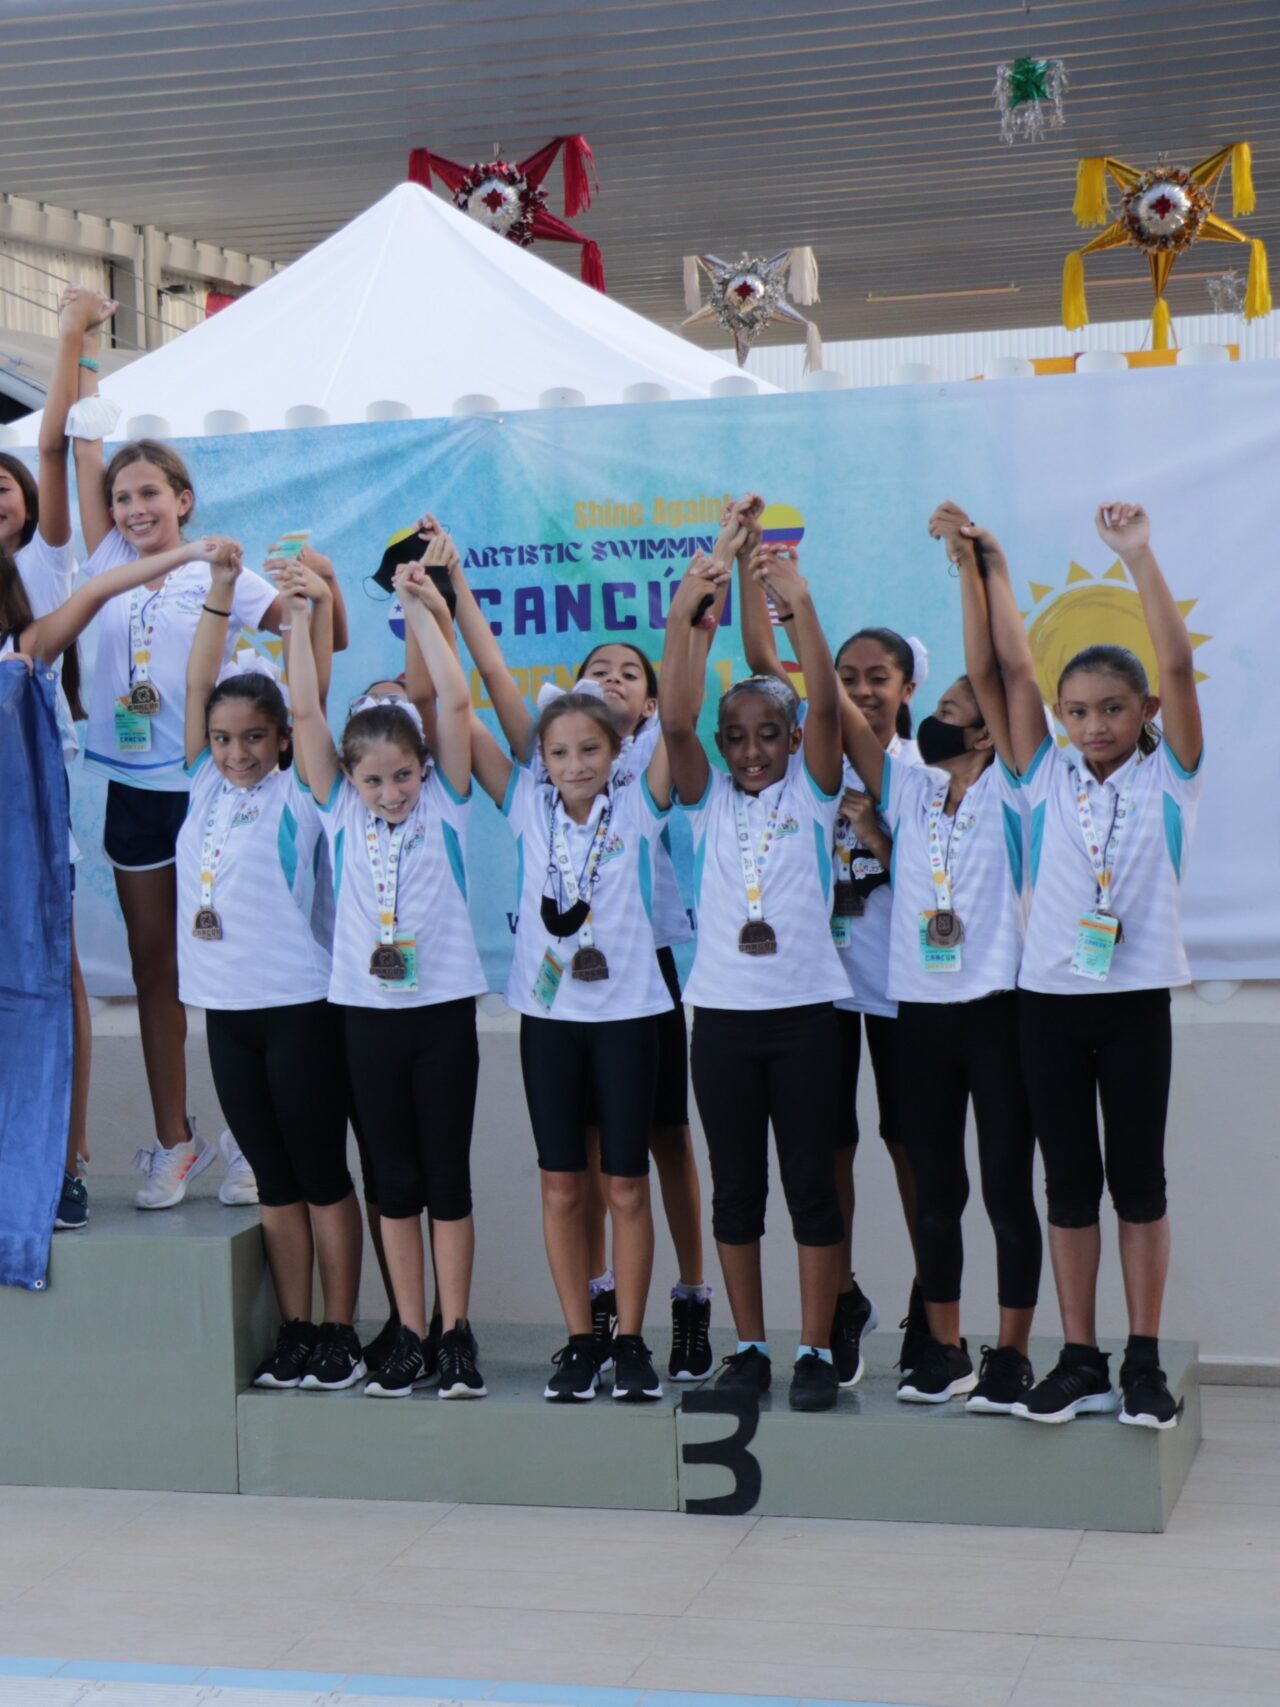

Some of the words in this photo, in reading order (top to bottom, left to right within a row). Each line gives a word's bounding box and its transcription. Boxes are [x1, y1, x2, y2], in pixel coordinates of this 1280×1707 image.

[575, 500, 643, 529] Shine
[463, 541, 583, 568] ARTISTIC
[591, 536, 718, 562] SWIMMIN
[681, 1390, 762, 1515] 3
